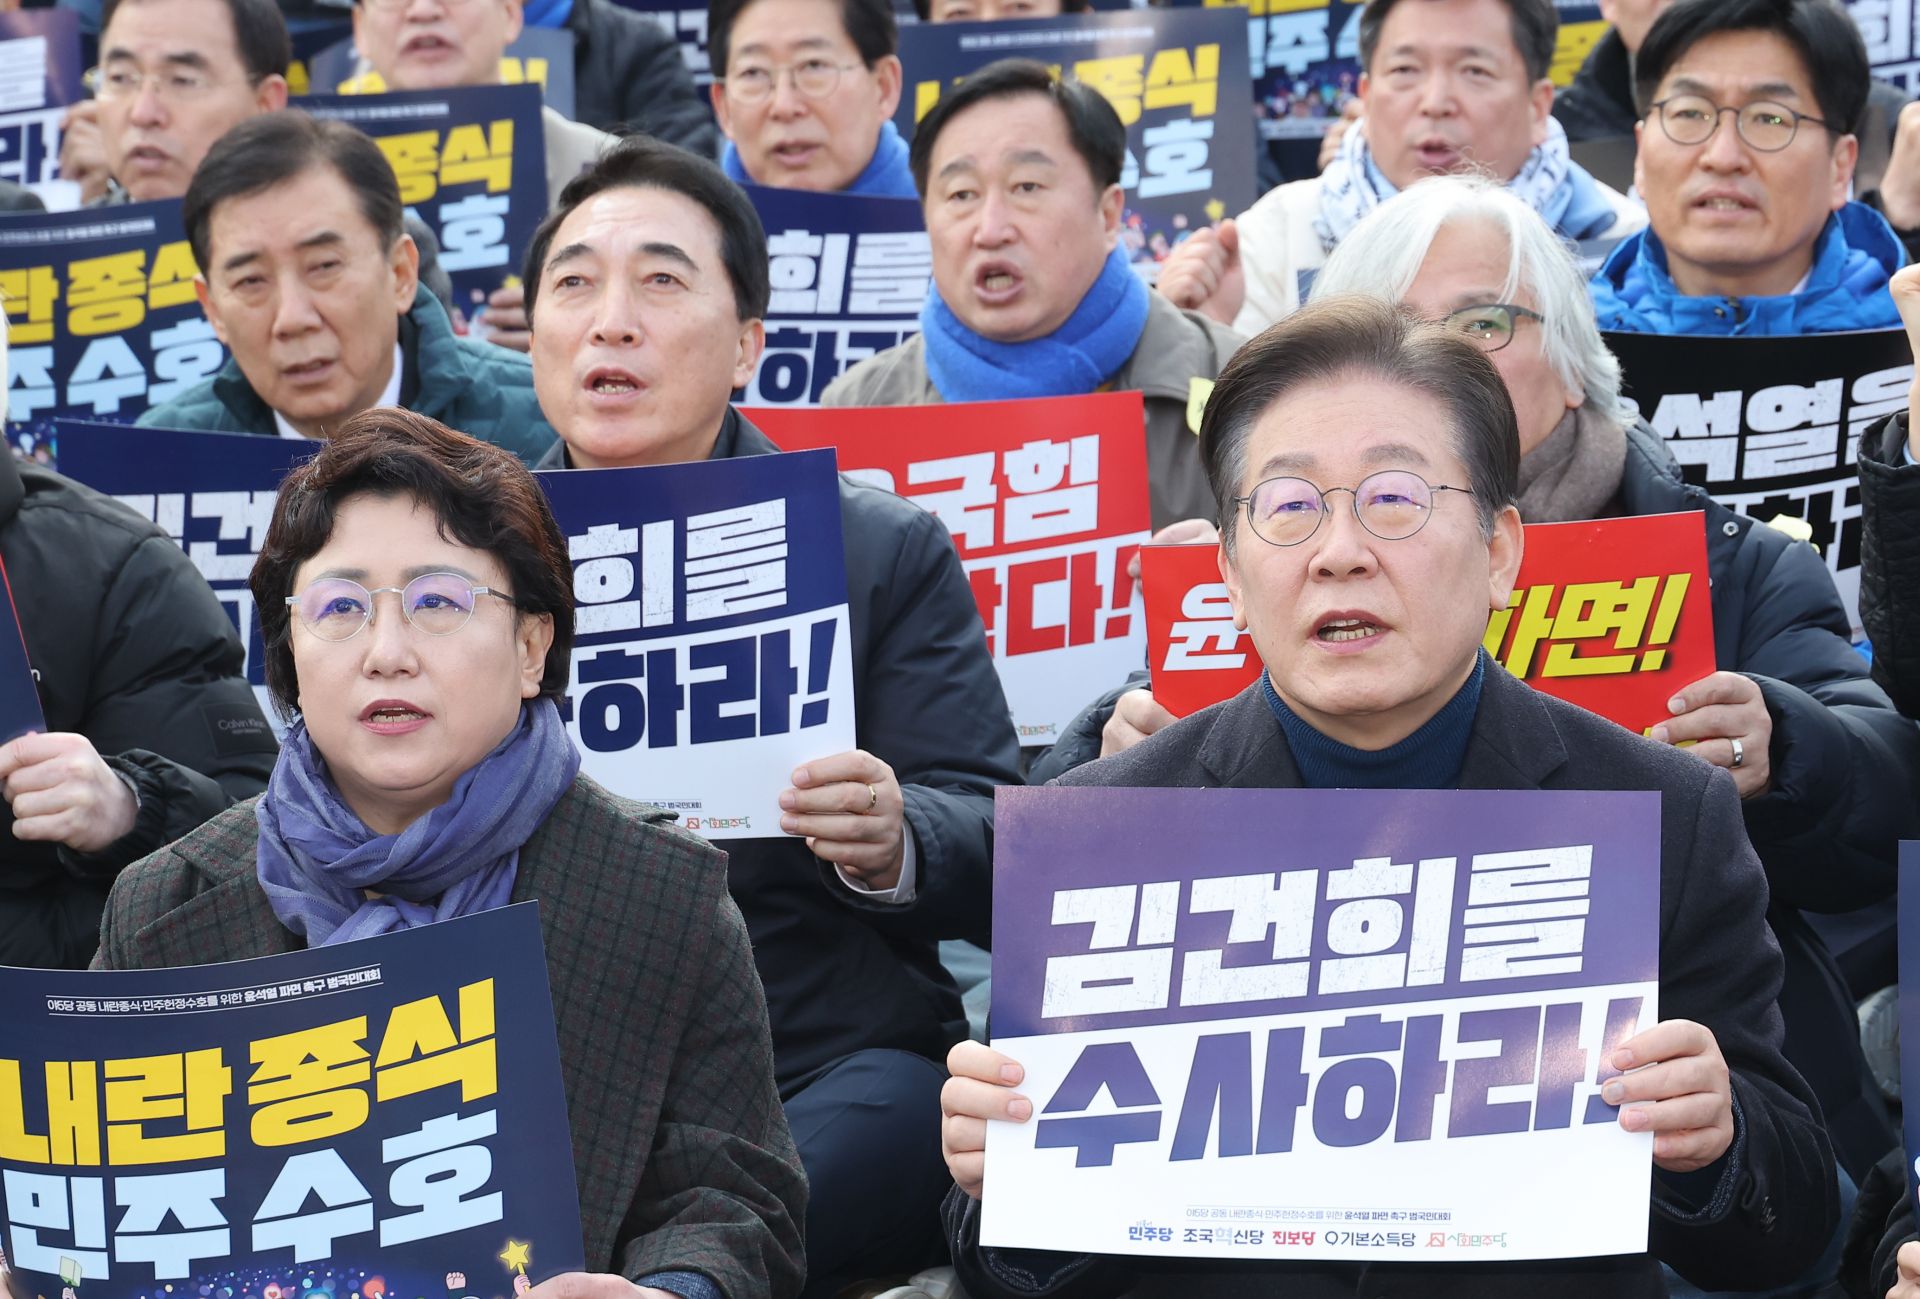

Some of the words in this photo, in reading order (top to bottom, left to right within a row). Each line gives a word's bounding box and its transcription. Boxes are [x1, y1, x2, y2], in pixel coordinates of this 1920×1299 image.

[1119, 119, 1213, 198] 호
[404, 195, 509, 272] 호
[768, 230, 931, 313] 희를
[758, 328, 918, 404] 하
[1618, 364, 1914, 483] 석열
[569, 498, 788, 635] 희를
[564, 618, 838, 753] 하라!
[1040, 844, 1594, 1020] 김건희를
[75, 1000, 97, 1012] 공동
[220, 994, 243, 1005] 위한
[244, 986, 277, 1003] 윤석열
[279, 983, 302, 997] 파면
[303, 979, 326, 993] 촉구
[327, 968, 381, 989] 범국민대회
[0, 1047, 232, 1166] 내란
[247, 977, 498, 1147] 종식
[1034, 996, 1645, 1169] 수사하라!
[3, 1167, 231, 1281] 민주
[251, 1108, 503, 1264] 수호
[1129, 1226, 1174, 1242] 민주당
[1183, 1227, 1264, 1246] 조국혁신당
[1273, 1231, 1316, 1246] 진보당
[1341, 1232, 1416, 1247] 기본소득당
[1345, 1210, 1369, 1221] 윤석열
[1371, 1211, 1389, 1221] 파면
[1409, 1211, 1451, 1222] 범국민대회
